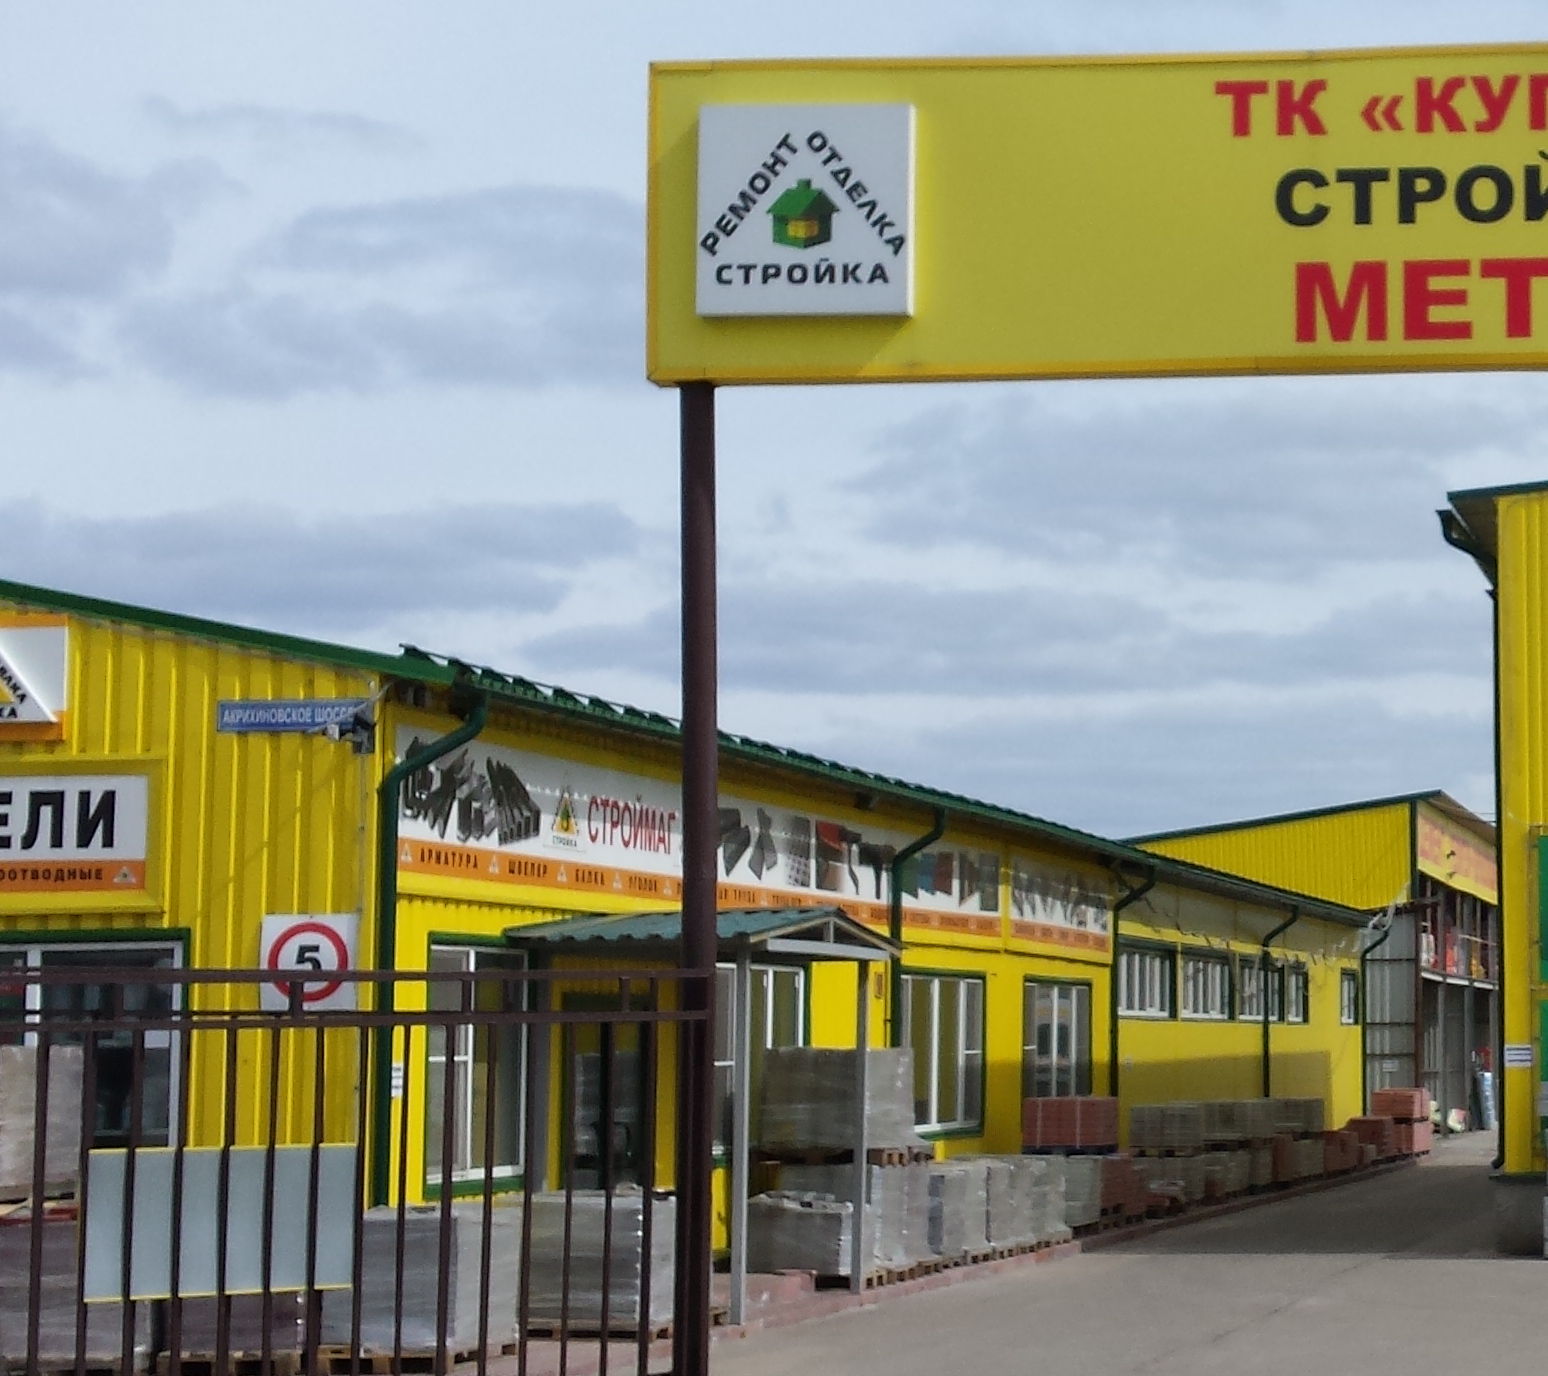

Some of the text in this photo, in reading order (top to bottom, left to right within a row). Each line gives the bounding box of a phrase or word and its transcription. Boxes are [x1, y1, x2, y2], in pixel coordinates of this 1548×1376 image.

[1216, 80, 1328, 137] ТК
[700, 132, 798, 257] РЕМОНТ
[806, 130, 906, 257] ОТДЕЛКА
[715, 257, 889, 285] СТРОЙКА
[587, 794, 677, 855] СТРОЙМАГ
[295, 944, 322, 971] 5
